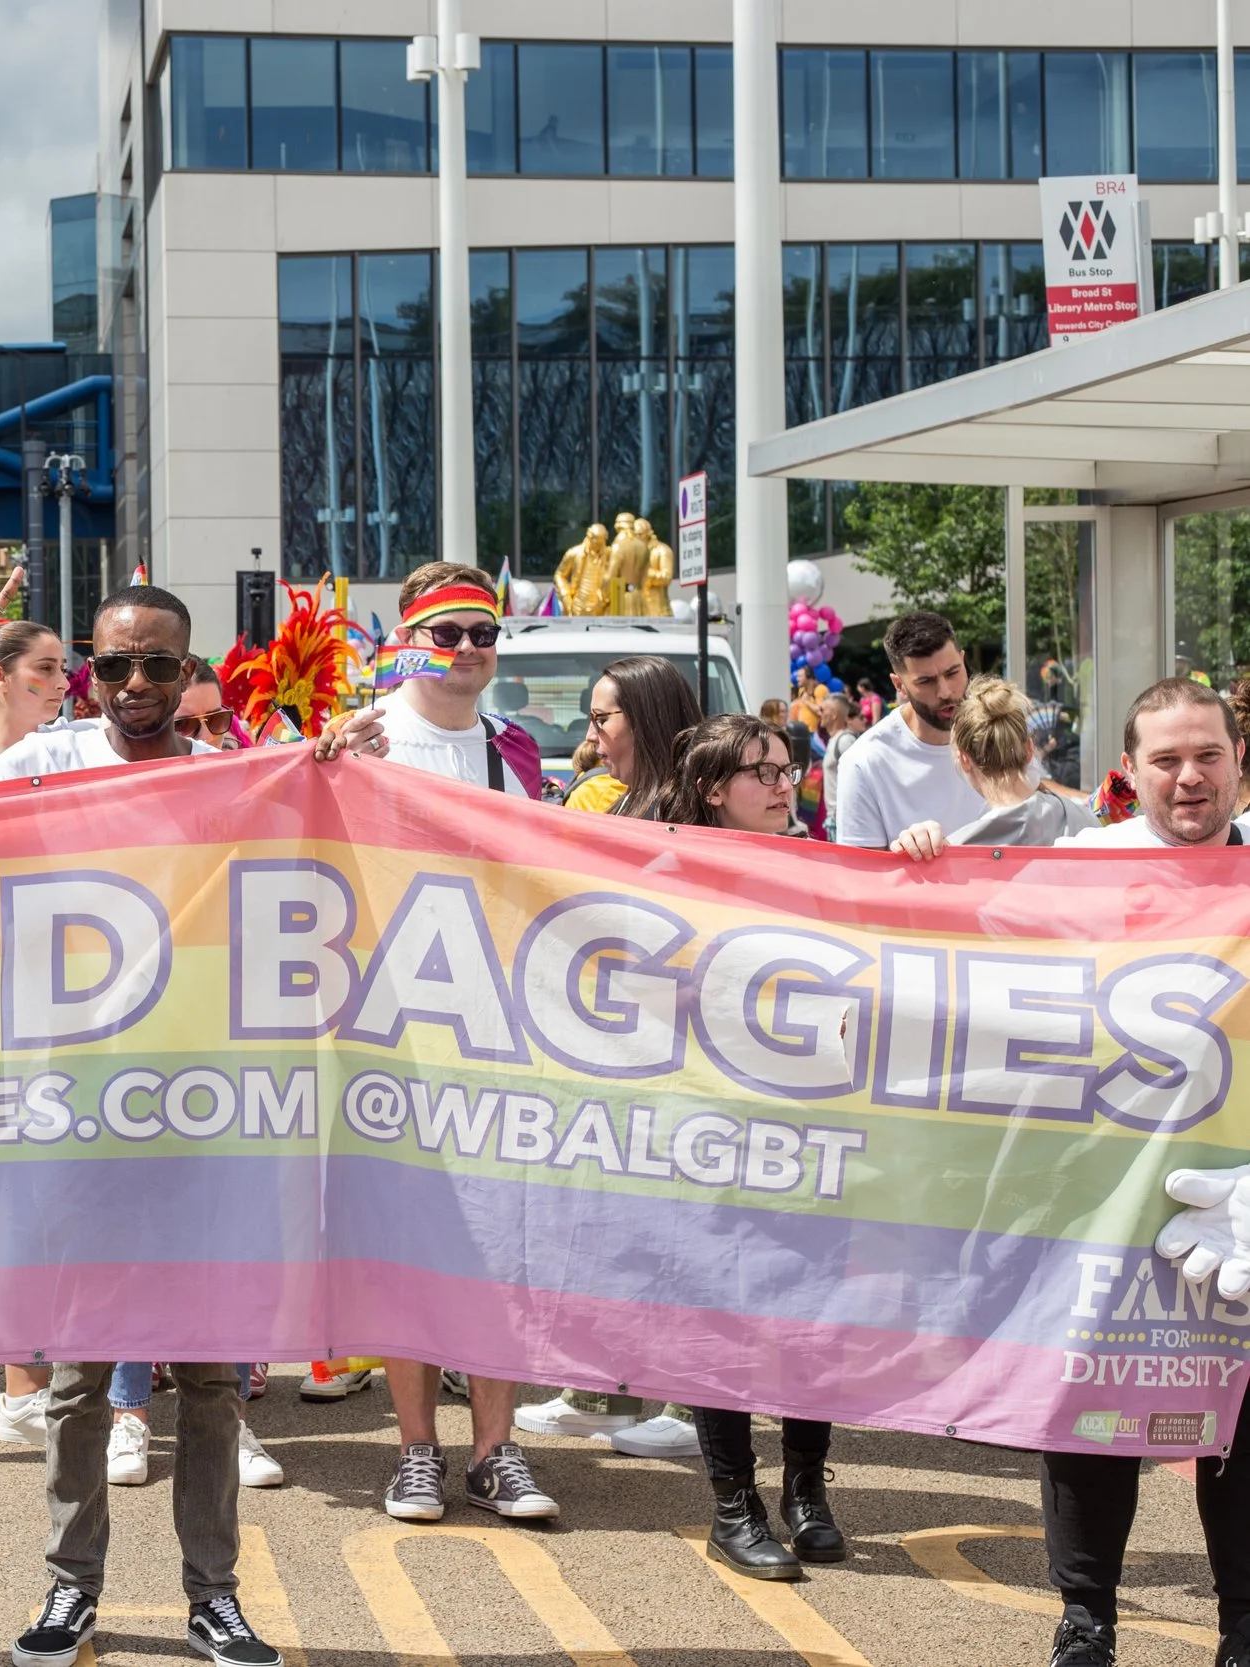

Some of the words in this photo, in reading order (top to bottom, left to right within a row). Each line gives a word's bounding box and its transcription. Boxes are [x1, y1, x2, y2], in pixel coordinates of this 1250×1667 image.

[1096, 181, 1126, 195] BR4
[1069, 268, 1086, 277] Bus
[1089, 267, 1113, 278] Stop
[1071, 288, 1100, 298] Broad
[1101, 287, 1112, 297] St
[1048, 303, 1081, 314] Library
[1084, 301, 1113, 312] Metro
[1115, 301, 1137, 312] Stop
[1055, 321, 1086, 331] towards
[1088, 320, 1104, 330] City
[229, 858, 1248, 1134] BAGGIES
[342, 1069, 868, 1200] @WBALGBT
[1150, 1328, 1190, 1348] FOR
[1060, 1351, 1244, 1387] DIVERSITY
[1081, 1415, 1105, 1431] KICK
[1119, 1418, 1141, 1433] OUT
